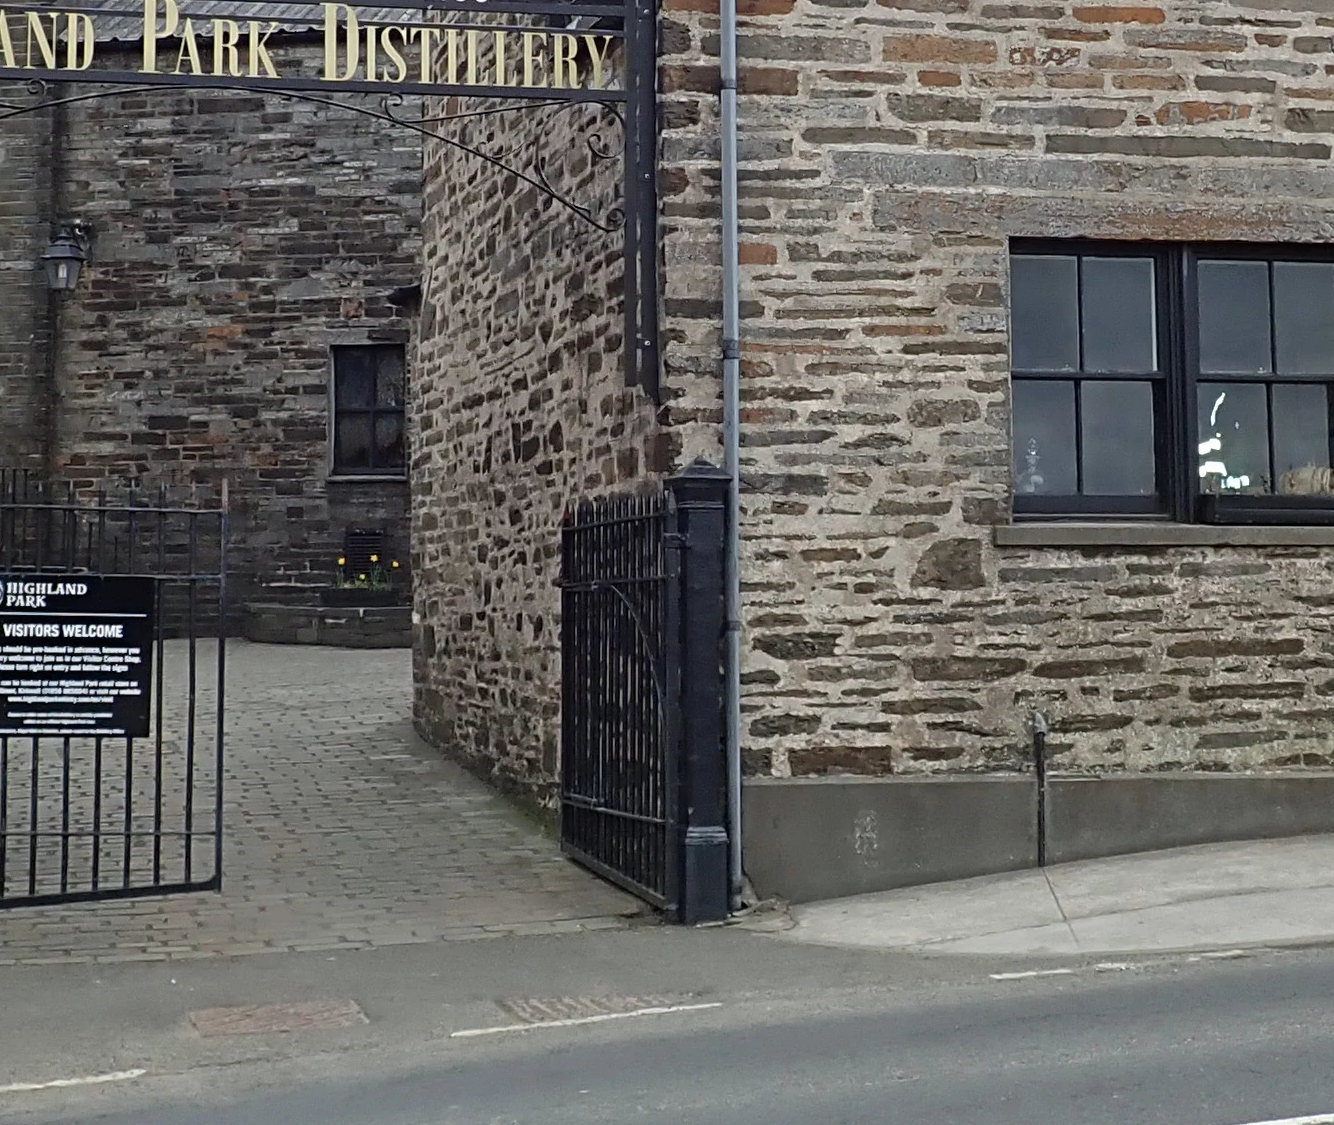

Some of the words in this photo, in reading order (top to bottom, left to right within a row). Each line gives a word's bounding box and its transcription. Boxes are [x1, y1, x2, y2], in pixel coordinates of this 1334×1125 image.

[320, 2, 614, 91] DISTILLERY
[6, 582, 88, 595] HIGHLAND
[6, 595, 47, 608] PARK
[3, 623, 60, 638] VISITORS
[62, 624, 124, 639] WELCOME
